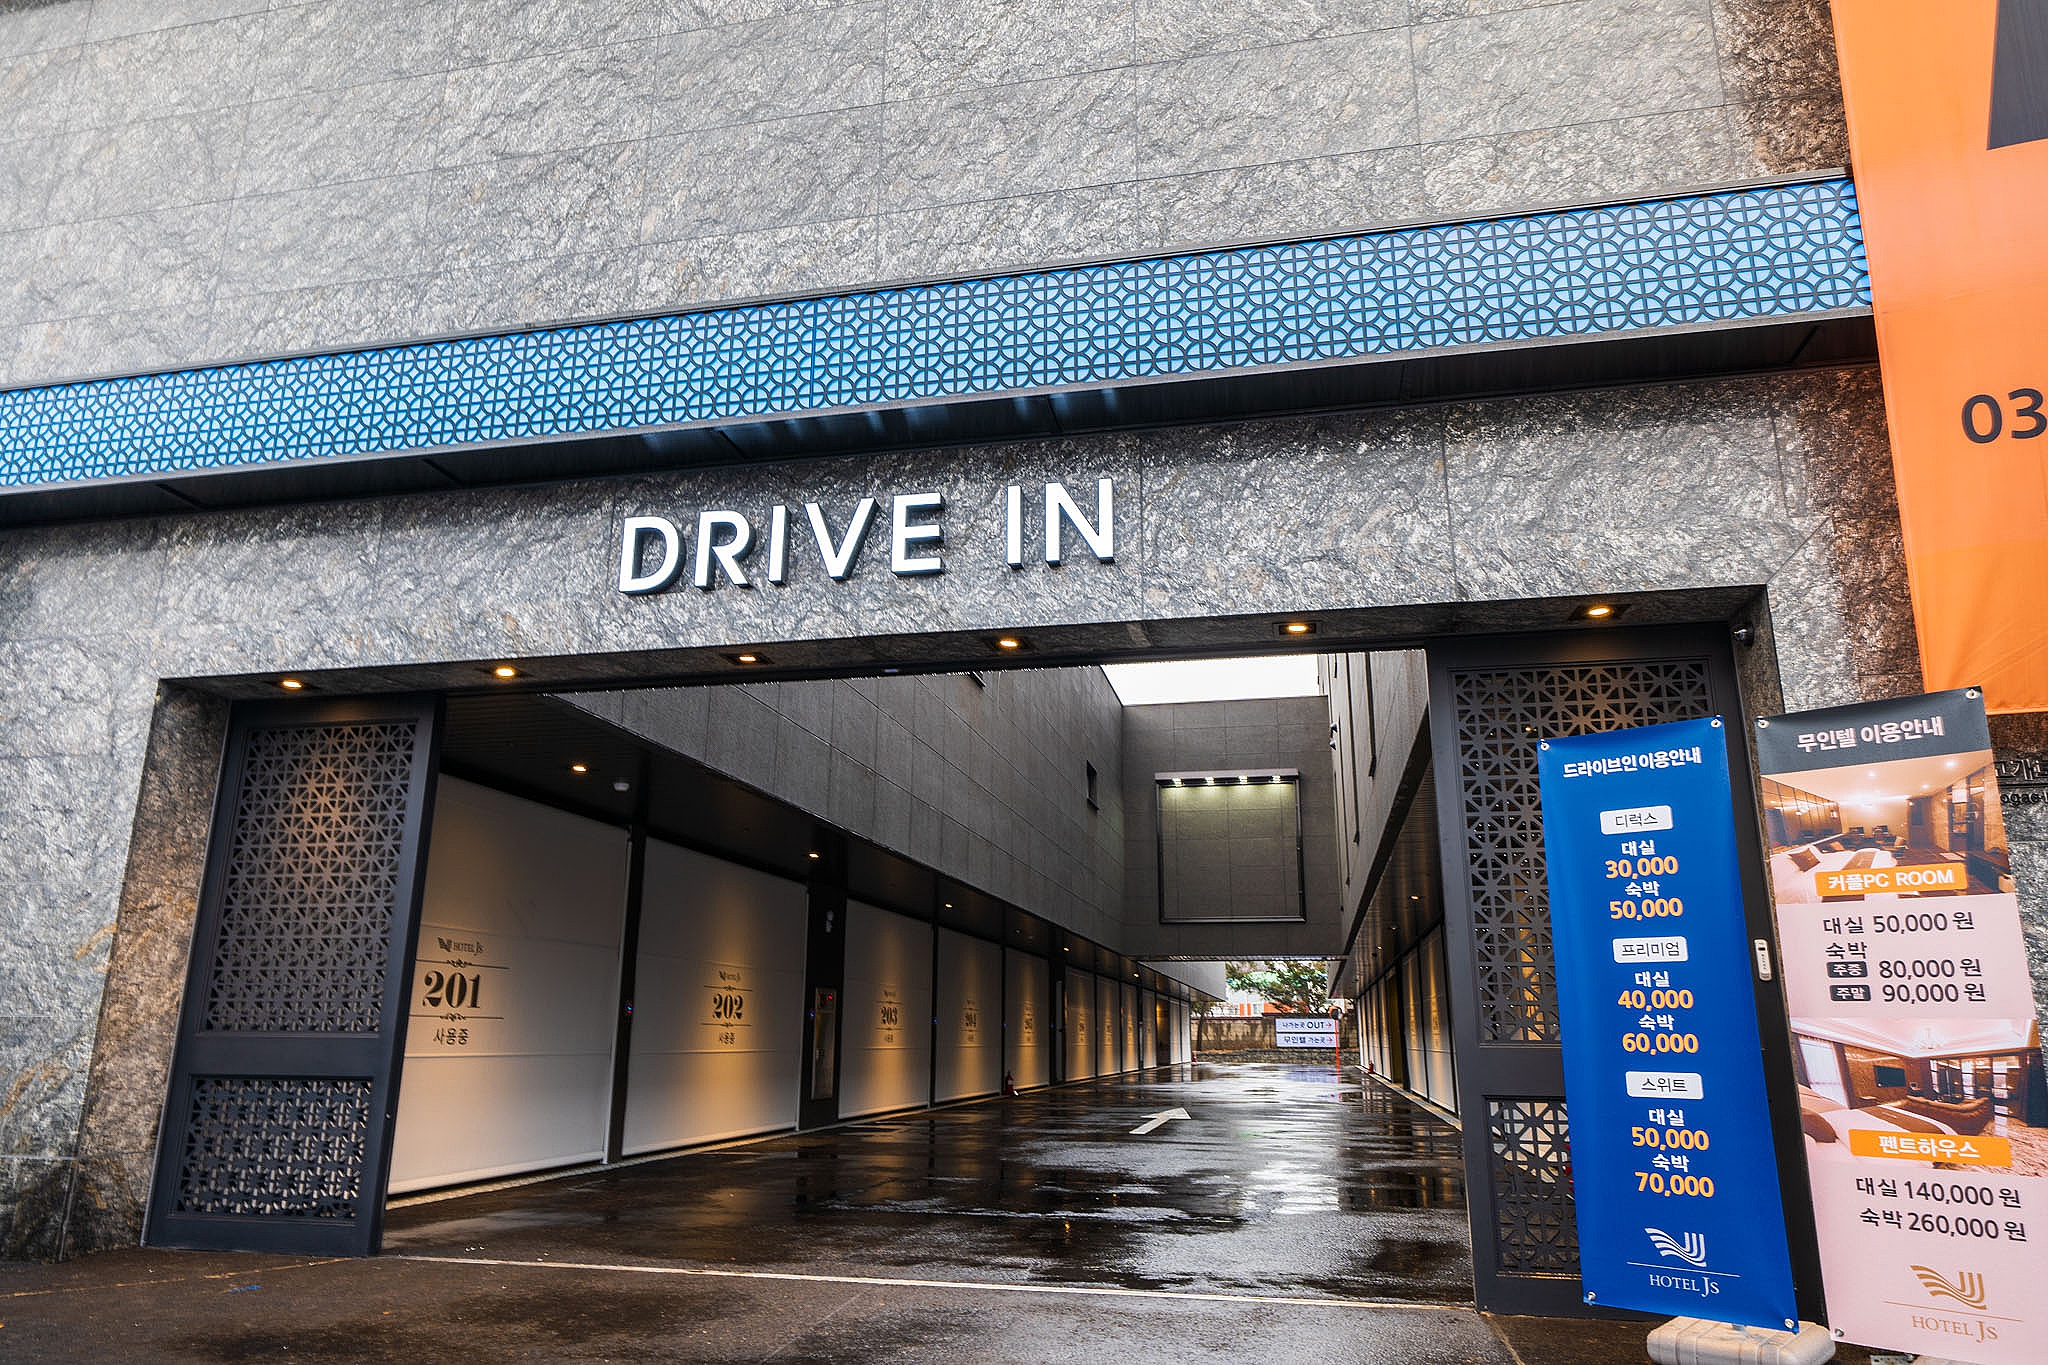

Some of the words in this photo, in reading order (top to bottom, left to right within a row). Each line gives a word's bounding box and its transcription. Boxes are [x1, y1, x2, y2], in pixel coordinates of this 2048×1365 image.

[619, 492, 945, 595] DRIVE
[1006, 478, 1116, 570] IN
[1797, 727, 1857, 752] 무인텔
[1860, 716, 1945, 745] 이용안내
[1563, 755, 1638, 779] 드라이브인
[1639, 746, 1703, 770] 이용안내
[1615, 812, 1659, 829] 디럭스
[1621, 840, 1655, 857] 대실
[1605, 856, 1679, 880] 30,000
[1625, 880, 1660, 897] 숙박
[1827, 872, 1890, 892] 커플PC
[1896, 868, 1955, 888] ROOM
[1609, 898, 1683, 920] 50,000
[1823, 916, 1865, 935] 대실
[1873, 913, 1948, 934] 50,000
[1953, 911, 1975, 931] 원
[1621, 942, 1680, 958] 프리미엄
[1825, 941, 1868, 960] 숙박
[1635, 971, 1670, 988] 대실
[1879, 959, 1955, 980] 80,000
[1960, 958, 1983, 977] 원
[422, 970, 481, 1009] 201
[1618, 989, 1694, 1012] 40,000
[1836, 986, 1866, 1000] 주말
[1882, 983, 1959, 1004] 90,000
[1964, 982, 1987, 1002] 원
[712, 992, 743, 1020] 202
[881, 1005, 898, 1027] 203
[1306, 1021, 1324, 1029] OUT
[1638, 1014, 1675, 1031] 숙박
[433, 1027, 470, 1046] 사용중
[1622, 1033, 1699, 1055] 60,000
[1641, 1077, 1688, 1093] 스위트
[1648, 1108, 1685, 1127] 대실
[1631, 1127, 1710, 1151] 50,000
[1878, 1135, 1981, 1159] 펜트하우스
[1651, 1153, 1690, 1172] 숙박
[1635, 1171, 1715, 1198] 70,000
[1856, 1177, 1898, 1198] 대실
[1904, 1180, 1995, 1206] 140,000
[1998, 1186, 2022, 1209] 원
[1859, 1207, 1903, 1229] 숙박
[1908, 1212, 2000, 1239] 260,000
[2003, 1219, 2028, 1242] 원
[1649, 1274, 1700, 1292] HOTEL
[1911, 1315, 1974, 1337] HOTEL
